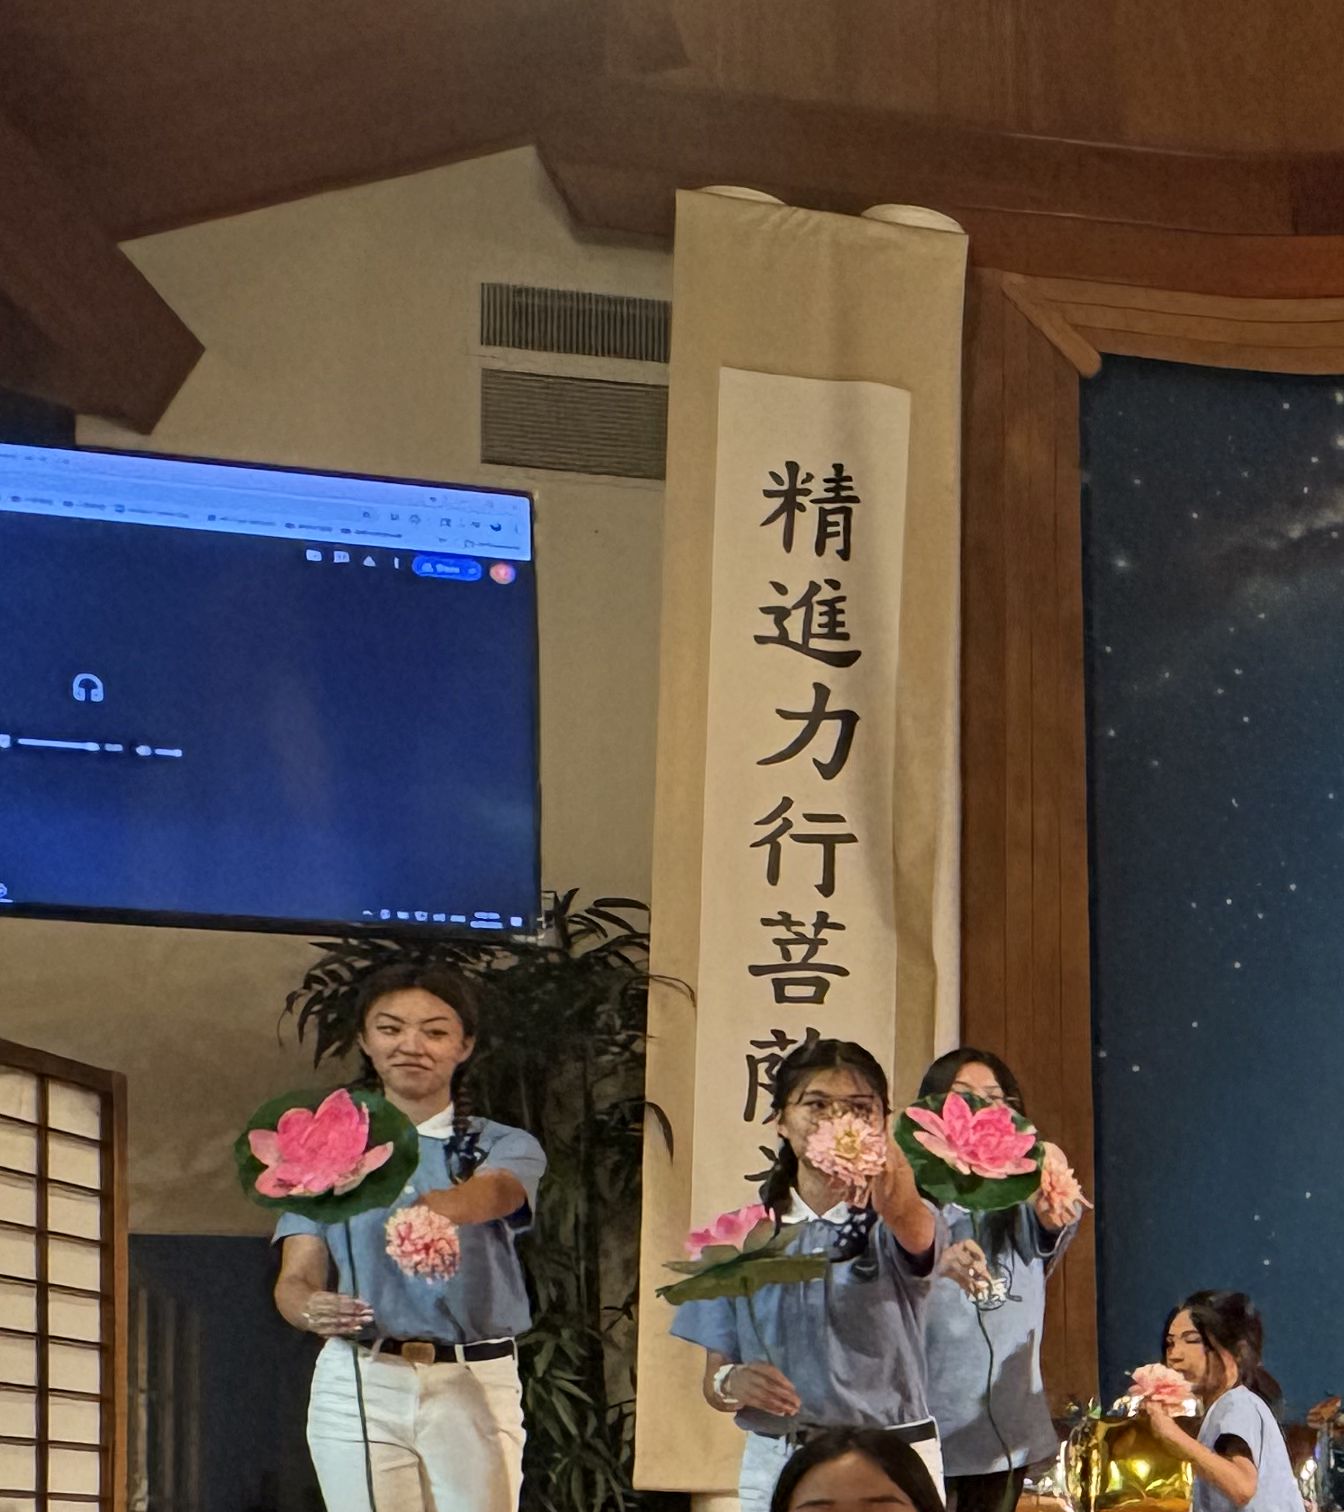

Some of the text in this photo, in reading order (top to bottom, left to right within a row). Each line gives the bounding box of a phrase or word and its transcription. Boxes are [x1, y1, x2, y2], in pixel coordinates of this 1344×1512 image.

[742, 461, 862, 1190] 精進力行菩
